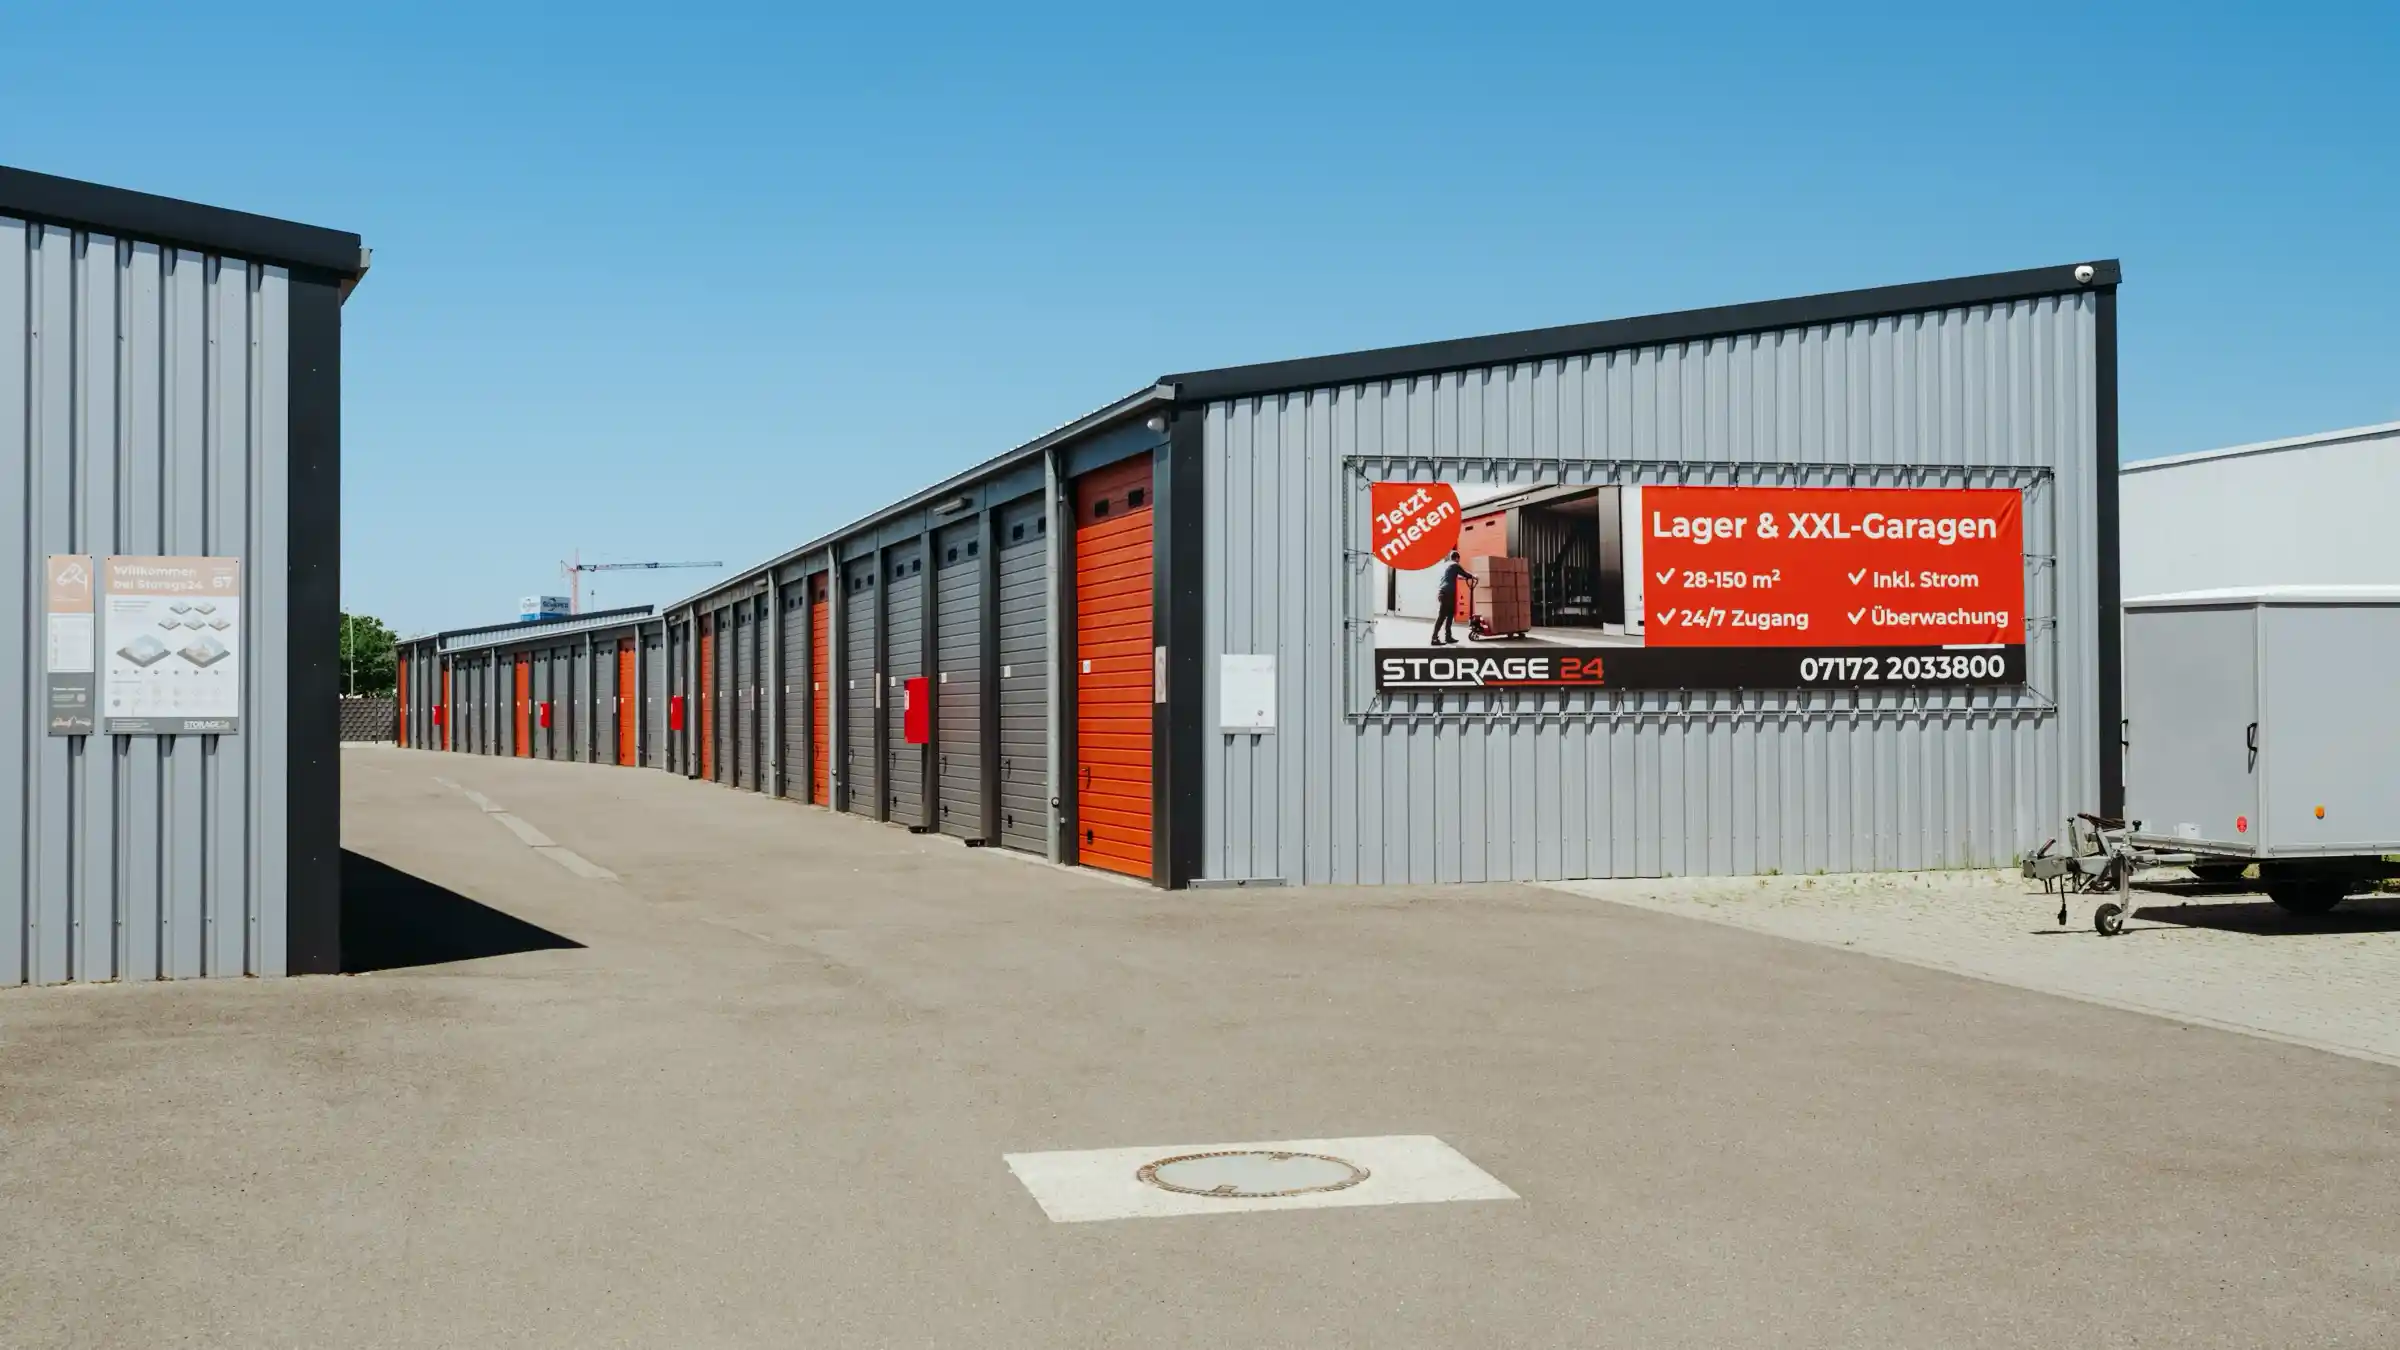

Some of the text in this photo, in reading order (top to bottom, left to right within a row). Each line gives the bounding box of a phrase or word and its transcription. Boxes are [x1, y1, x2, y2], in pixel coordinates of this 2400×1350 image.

[1375, 487, 1433, 534] Jetzt
[1380, 501, 1455, 561] mieten
[1653, 511, 1997, 546] Lager & XXL-Garagen
[113, 565, 198, 578] Willkommen
[212, 576, 233, 588] 67
[1683, 568, 1781, 589] 28-150 m²
[1873, 570, 1979, 589] Inkl. Strom
[1680, 607, 1809, 631] 24/7 Zugang
[1871, 605, 2009, 629] Überwachung
[1383, 657, 1604, 682] STORAGE 24
[1800, 655, 2005, 681] 07172 2033800
